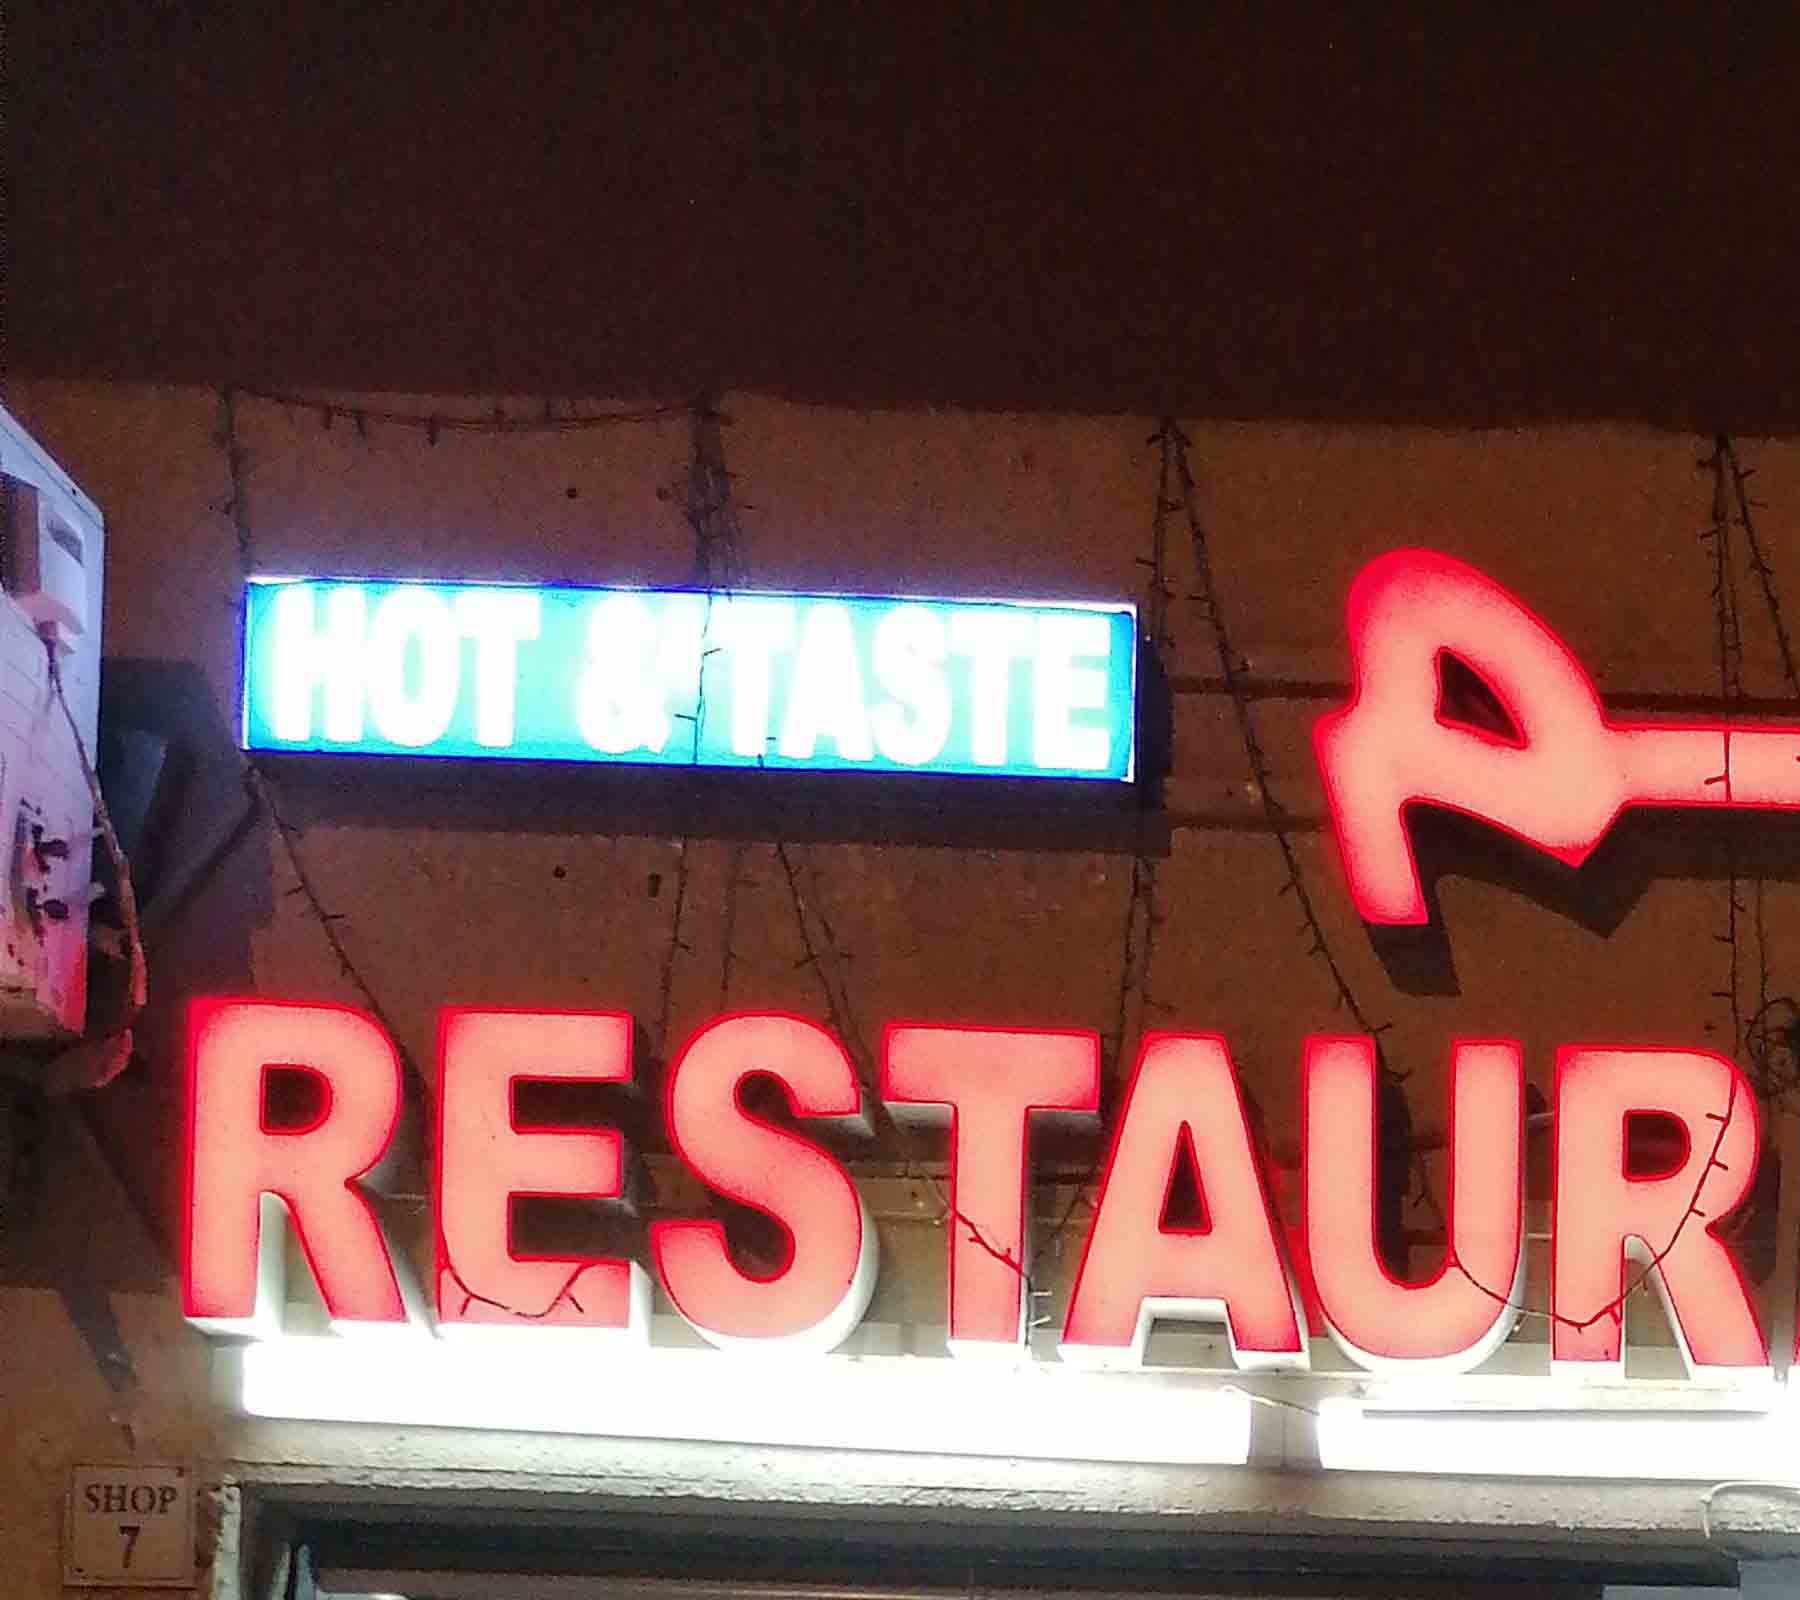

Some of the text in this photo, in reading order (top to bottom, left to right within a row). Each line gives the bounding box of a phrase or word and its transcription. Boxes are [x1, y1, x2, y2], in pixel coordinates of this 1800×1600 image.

[268, 586, 1113, 770] HOT & TASTE
[84, 1483, 178, 1514] SHOP
[118, 1524, 142, 1569] 7
